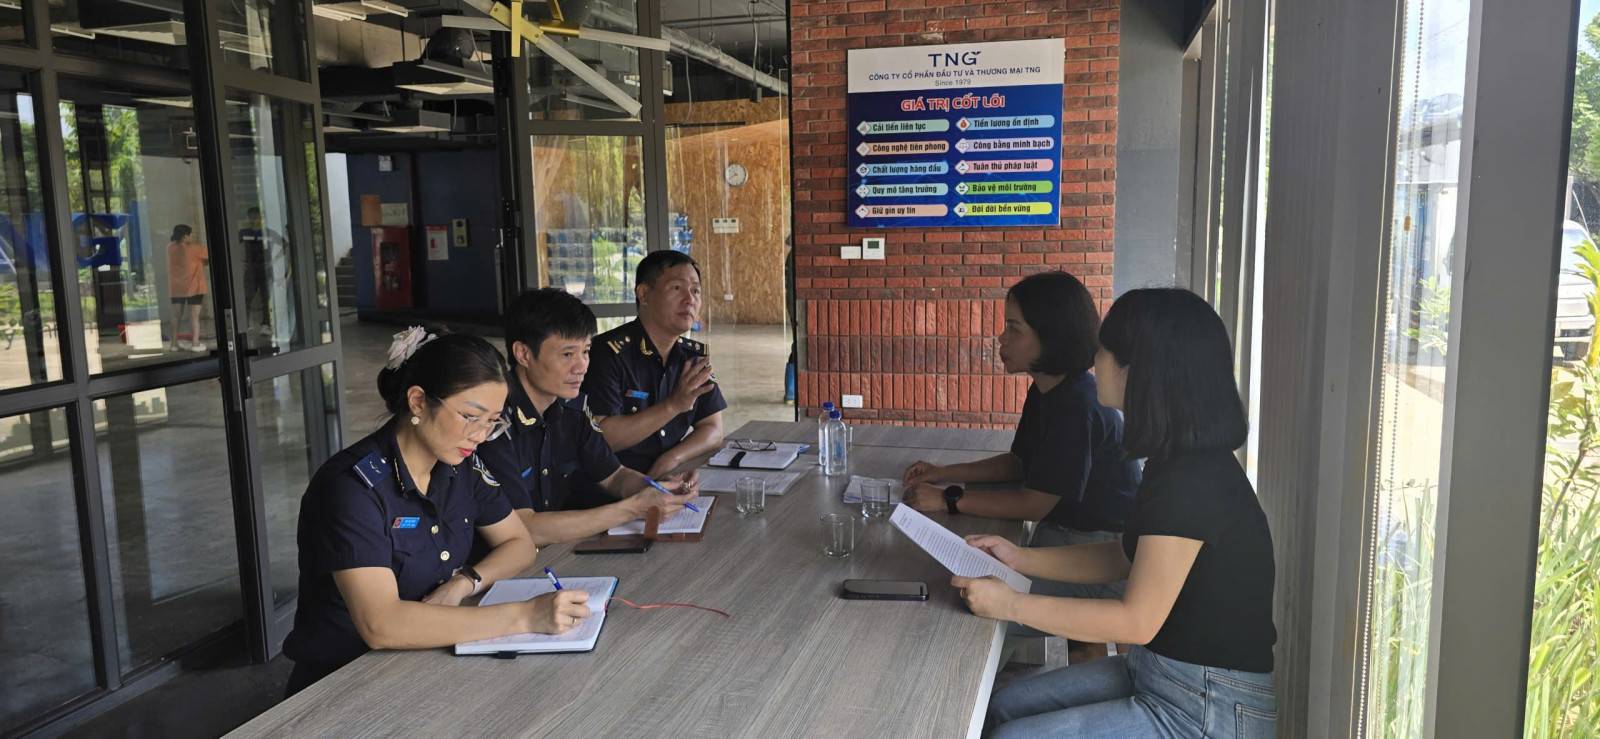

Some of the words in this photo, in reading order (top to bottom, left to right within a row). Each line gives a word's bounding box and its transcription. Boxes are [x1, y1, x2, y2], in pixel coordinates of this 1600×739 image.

[928, 51, 981, 68] TNG
[868, 71, 890, 81] CÔNG
[964, 68, 975, 76] VÀ
[935, 79, 953, 87] Since
[955, 78, 972, 86] 1979
[901, 96, 926, 112] GIÁ
[927, 97, 950, 112] TRỊ
[952, 92, 980, 109] CỐT
[900, 122, 914, 131] liên
[915, 122, 926, 131] tục
[1022, 117, 1039, 127] định
[872, 143, 890, 152] Công
[891, 143, 908, 153] nghệ
[924, 142, 946, 152] phong
[973, 140, 992, 149] Công
[1012, 140, 1031, 148] minh
[1032, 139, 1051, 148] bạch
[909, 164, 927, 173] hàng
[1004, 162, 1022, 171] pháp
[872, 186, 885, 194] Quy
[886, 185, 897, 193] mô
[987, 184, 996, 192] vệ
[897, 207, 905, 215] uy
